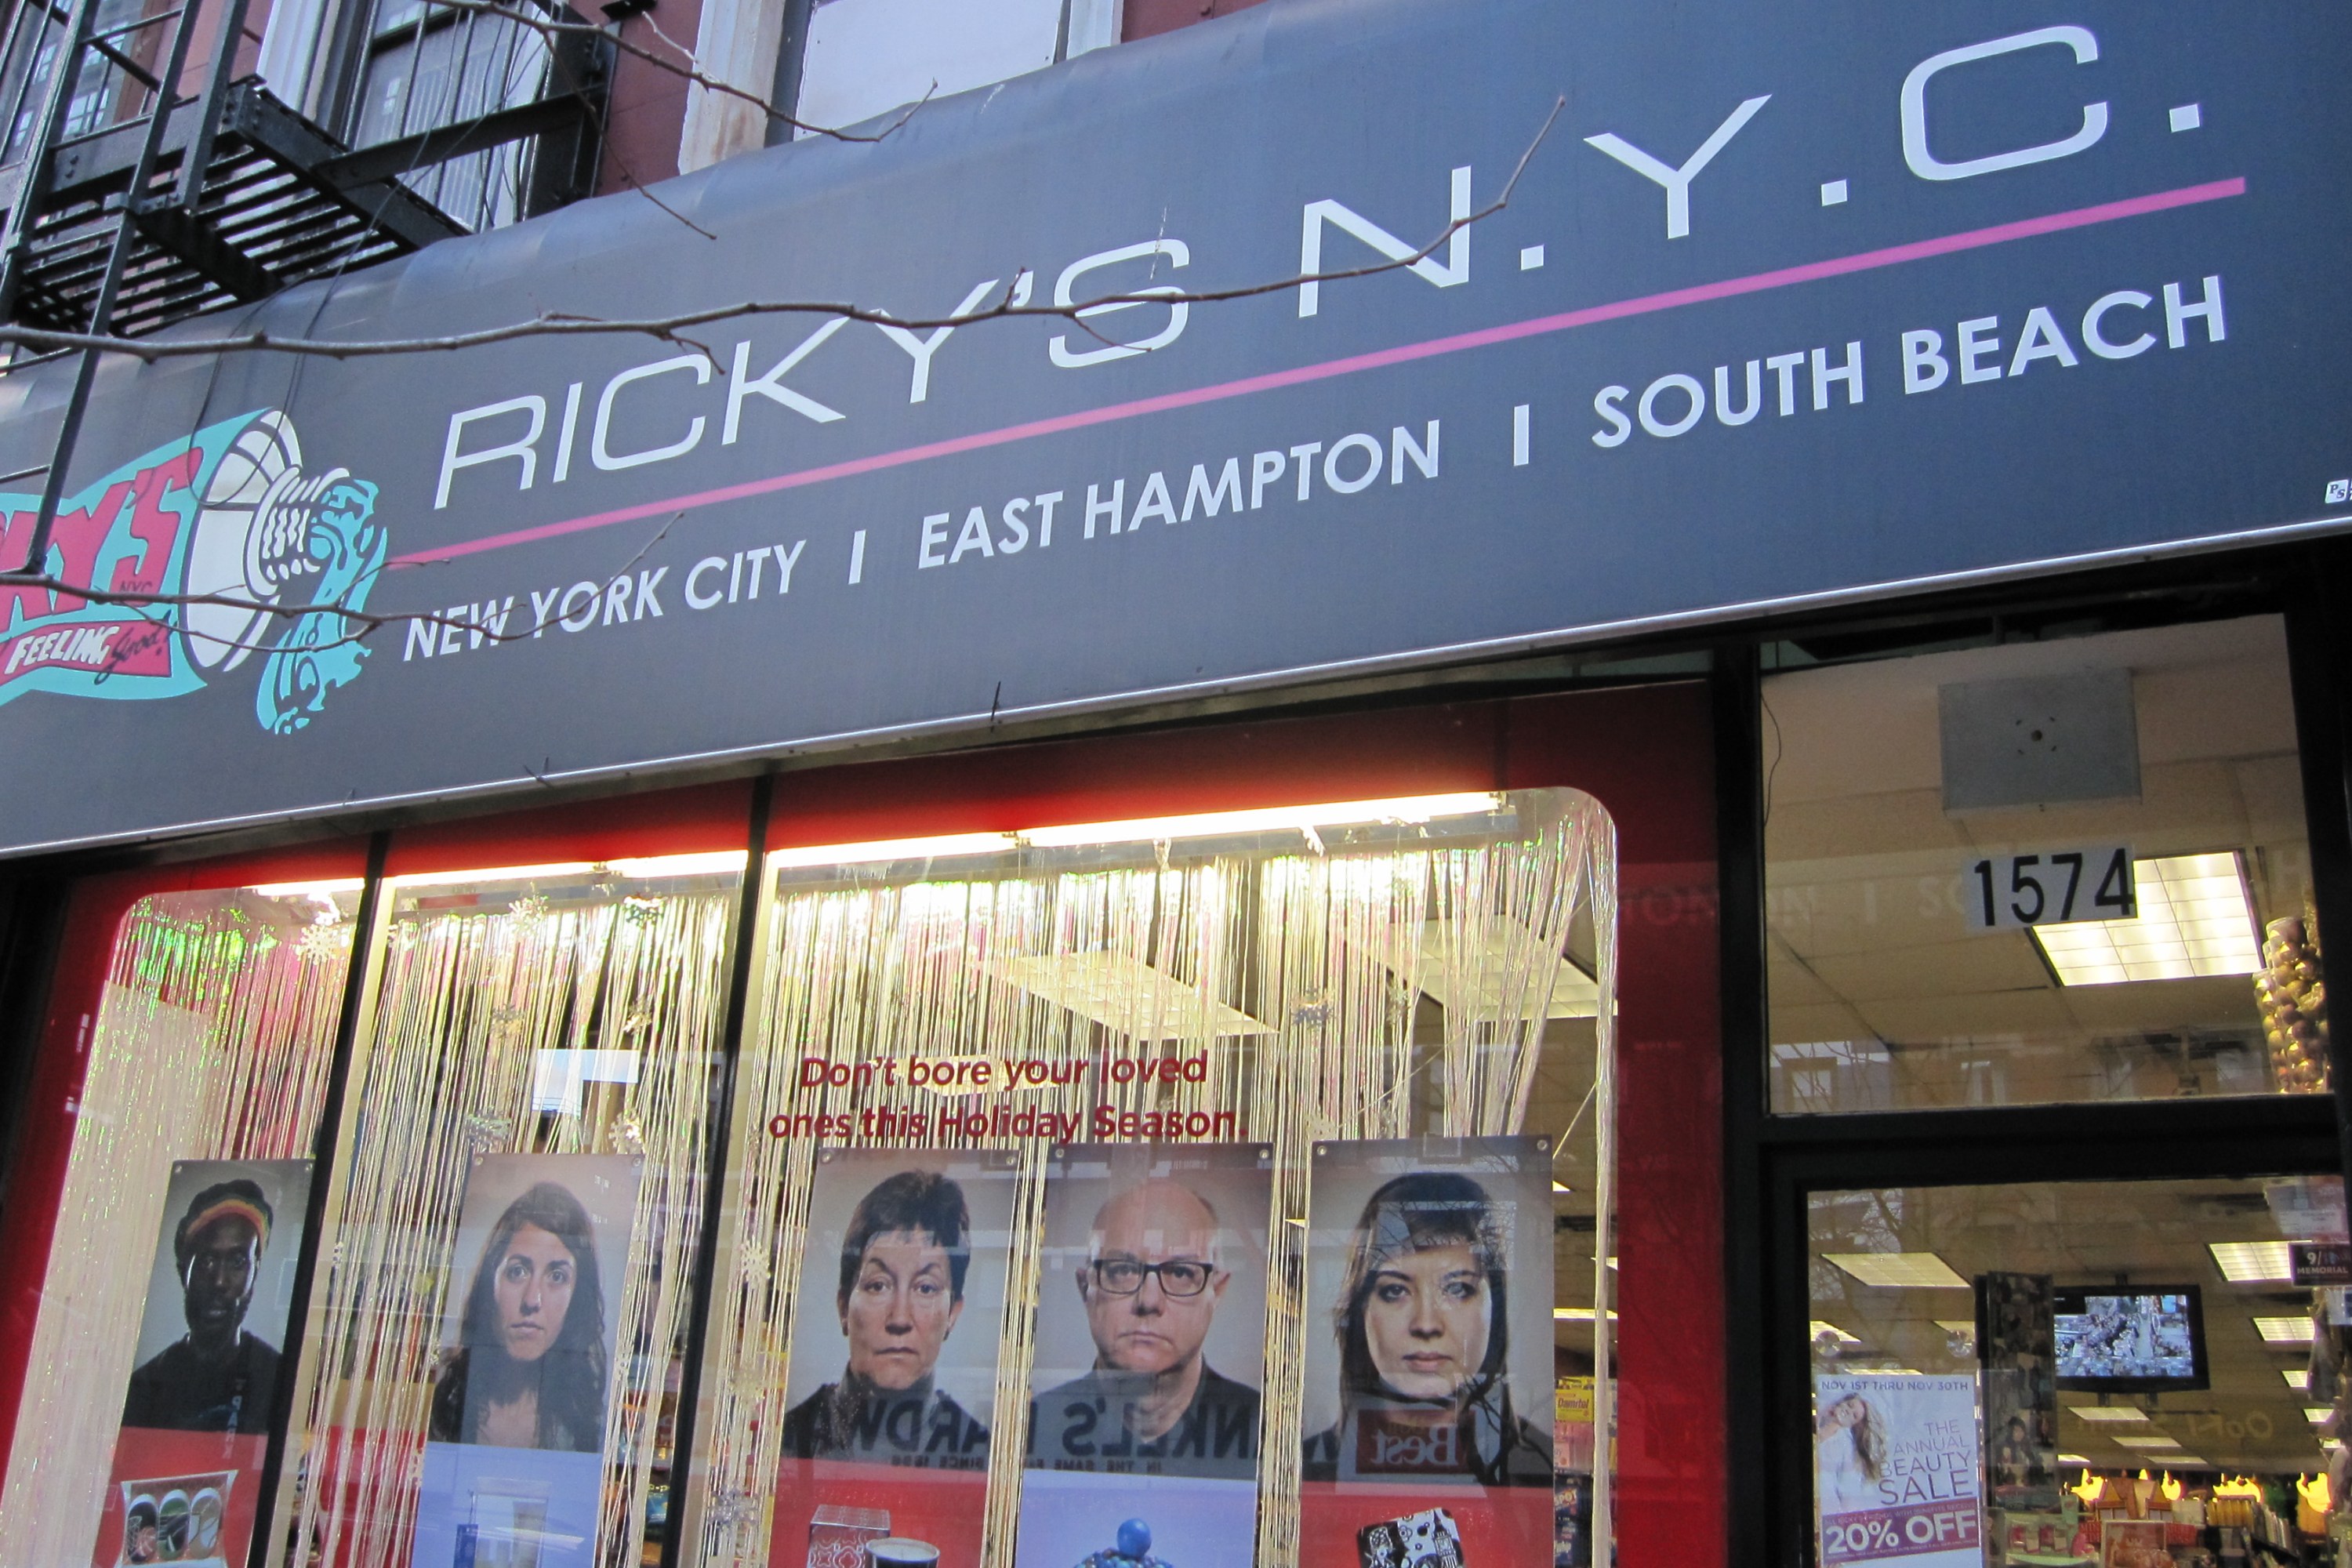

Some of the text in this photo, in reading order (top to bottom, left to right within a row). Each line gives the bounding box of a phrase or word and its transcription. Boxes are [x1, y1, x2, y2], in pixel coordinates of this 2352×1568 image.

[434, 238, 1190, 510] RICKY'S
[403, 597, 514, 662] NEW
[533, 566, 669, 638] YORK
[684, 539, 807, 609] CITY
[918, 490, 1063, 569] EAST
[1083, 419, 1439, 539] HAMPTON
[1591, 341, 1864, 448] SOUTH
[1900, 274, 2225, 395] BEACH
[4, 626, 120, 674] FEELING
[1974, 848, 2134, 927] 1574
[800, 1049, 1208, 1091] Don't bore your loved
[769, 1104, 1248, 1145] ones this Holiday Season.
[2297, 1266, 2349, 1275] MEMORIAL
[1821, 1381, 1846, 1390] NOV
[1873, 1381, 1904, 1391] THRU
[1907, 1381, 1933, 1391] NOV
[1938, 1381, 1969, 1391] 30TH
[1893, 1436, 1970, 1456] ANNUAL
[1924, 1419, 1960, 1436] THE
[1879, 1450, 1971, 1478] BEAUTY
[1878, 1468, 1973, 1505] SALE
[1825, 1519, 1900, 1555] 20%
[1905, 1509, 1976, 1544] OFF
